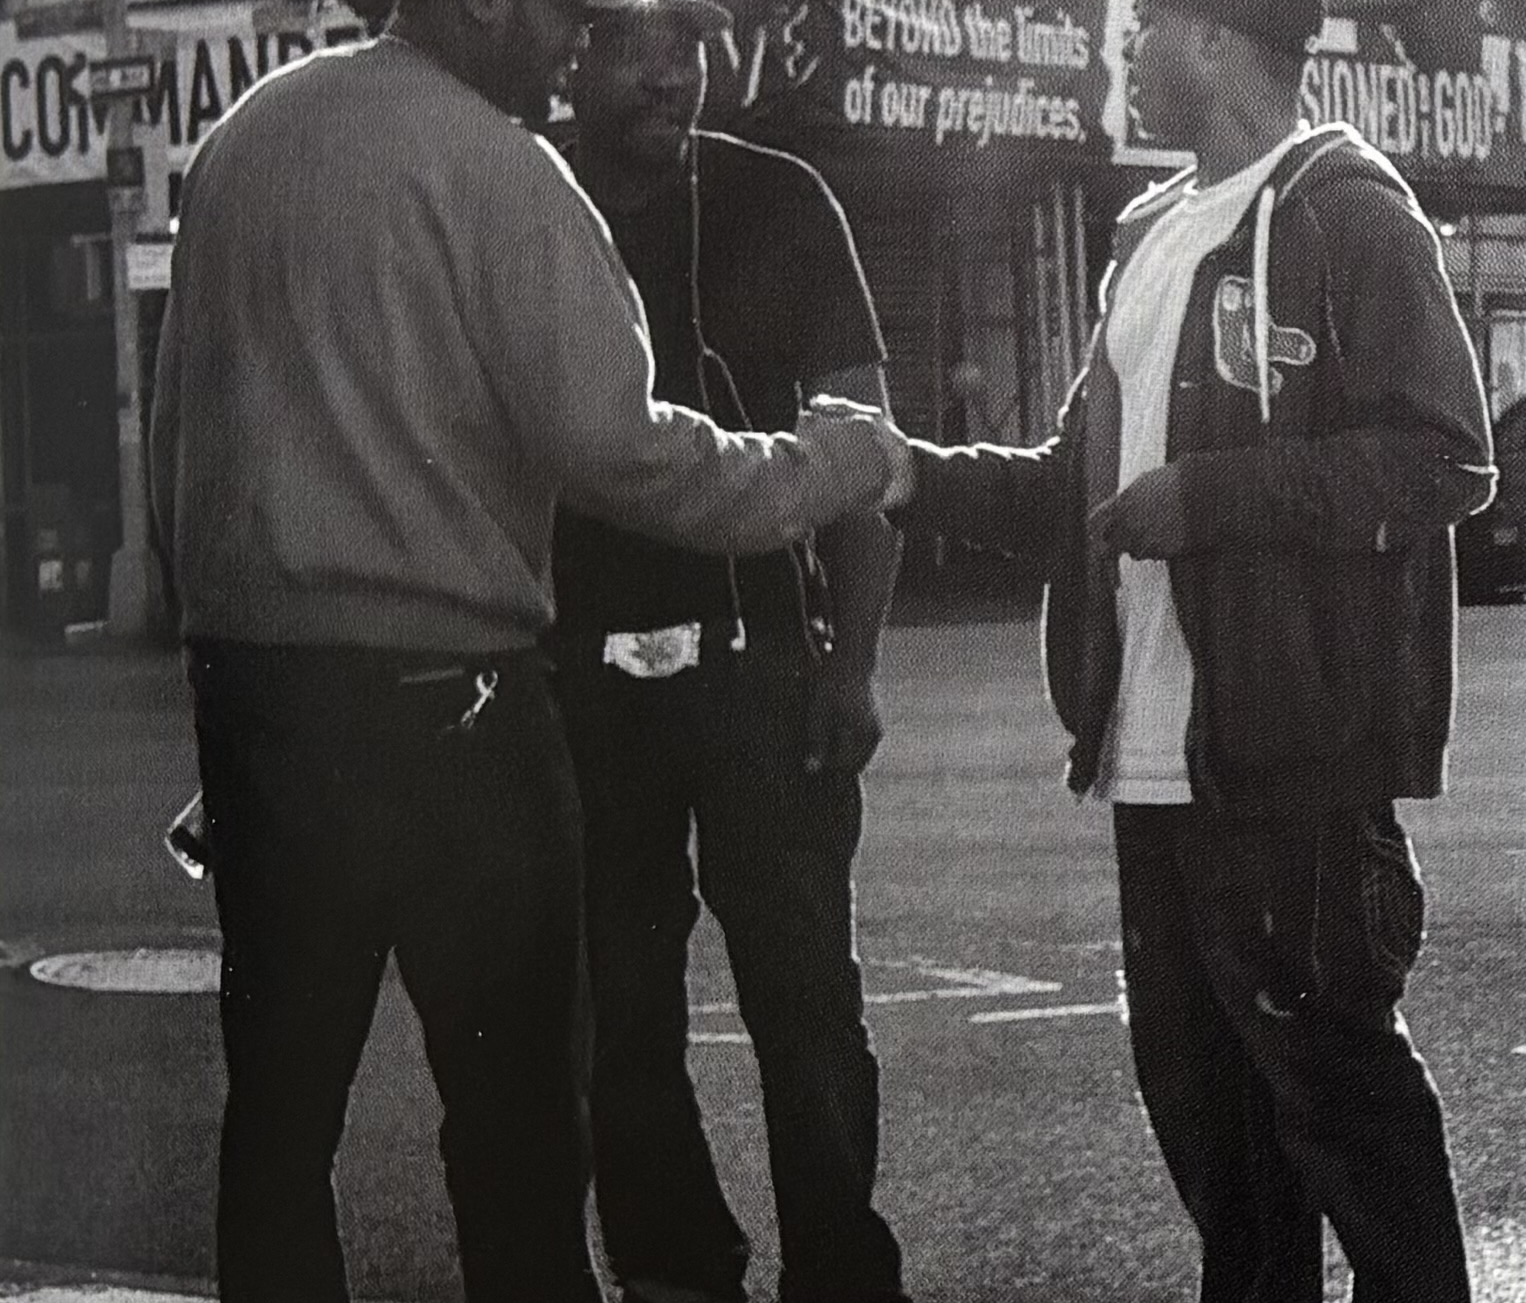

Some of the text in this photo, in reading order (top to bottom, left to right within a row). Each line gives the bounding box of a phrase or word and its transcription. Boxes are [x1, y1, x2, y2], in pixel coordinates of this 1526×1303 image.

[964, 3, 1013, 62] the
[1015, 5, 1090, 69] limits
[844, 65, 876, 124] of
[881, 81, 932, 129] our
[1299, 56, 1417, 156] SIONED
